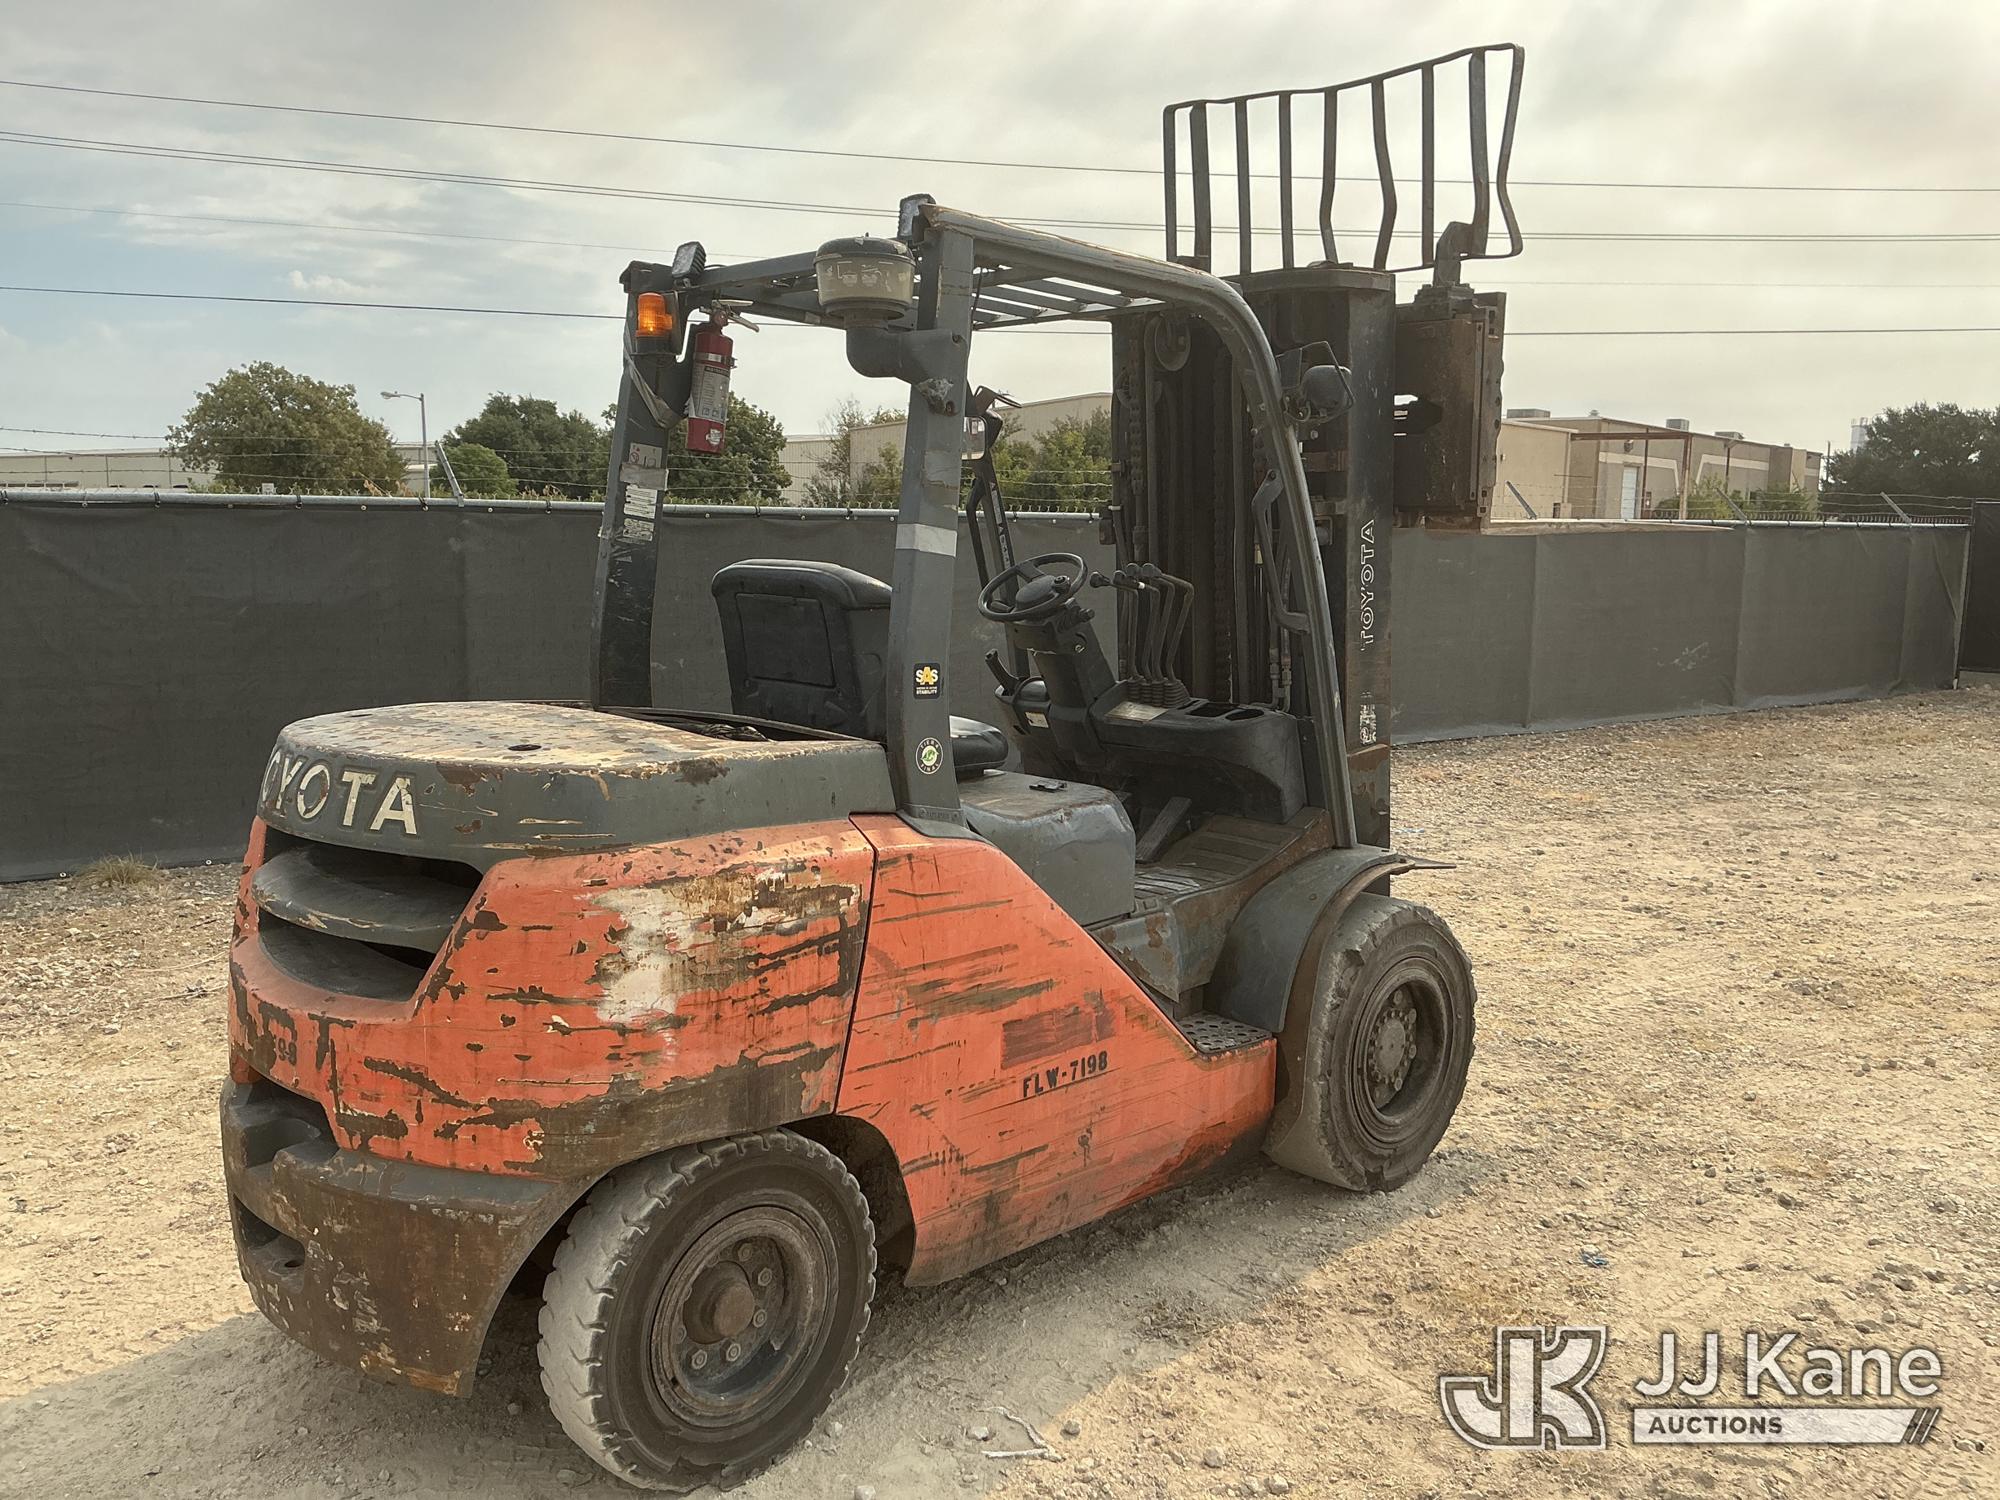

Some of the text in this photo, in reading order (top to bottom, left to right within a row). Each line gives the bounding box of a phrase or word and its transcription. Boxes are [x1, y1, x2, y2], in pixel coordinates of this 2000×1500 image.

[1360, 519, 1375, 651] TOYOTA
[915, 666, 939, 685] SAS
[262, 750, 417, 835] OYOTA
[1022, 1050, 1108, 1097] FLW-7198
